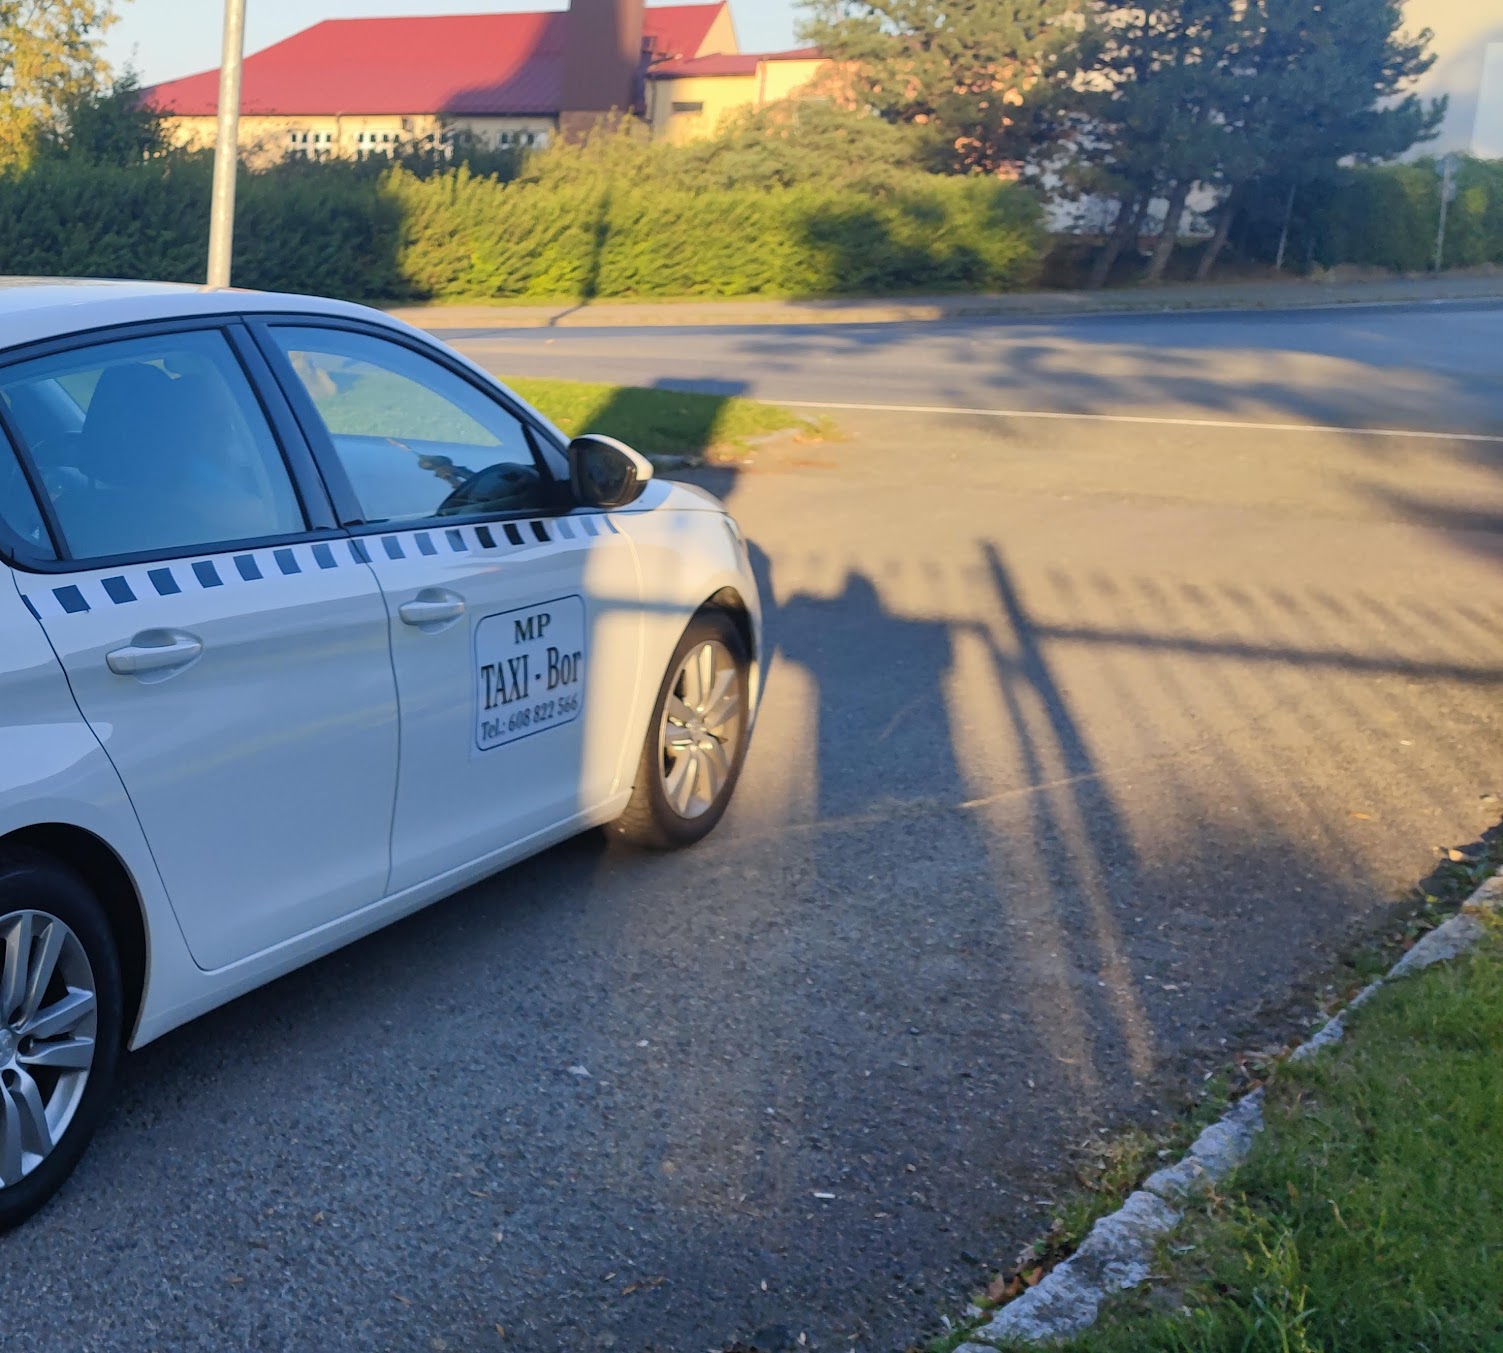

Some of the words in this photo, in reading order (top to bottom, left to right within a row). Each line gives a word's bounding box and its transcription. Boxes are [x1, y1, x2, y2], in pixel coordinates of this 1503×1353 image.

[514, 613, 551, 644] MP
[481, 654, 529, 710] TAXI
[547, 646, 581, 690] Bor
[481, 718, 506, 740] Tel.:
[508, 708, 531, 732] 608
[533, 700, 555, 723] 822
[557, 692, 578, 715] 566
